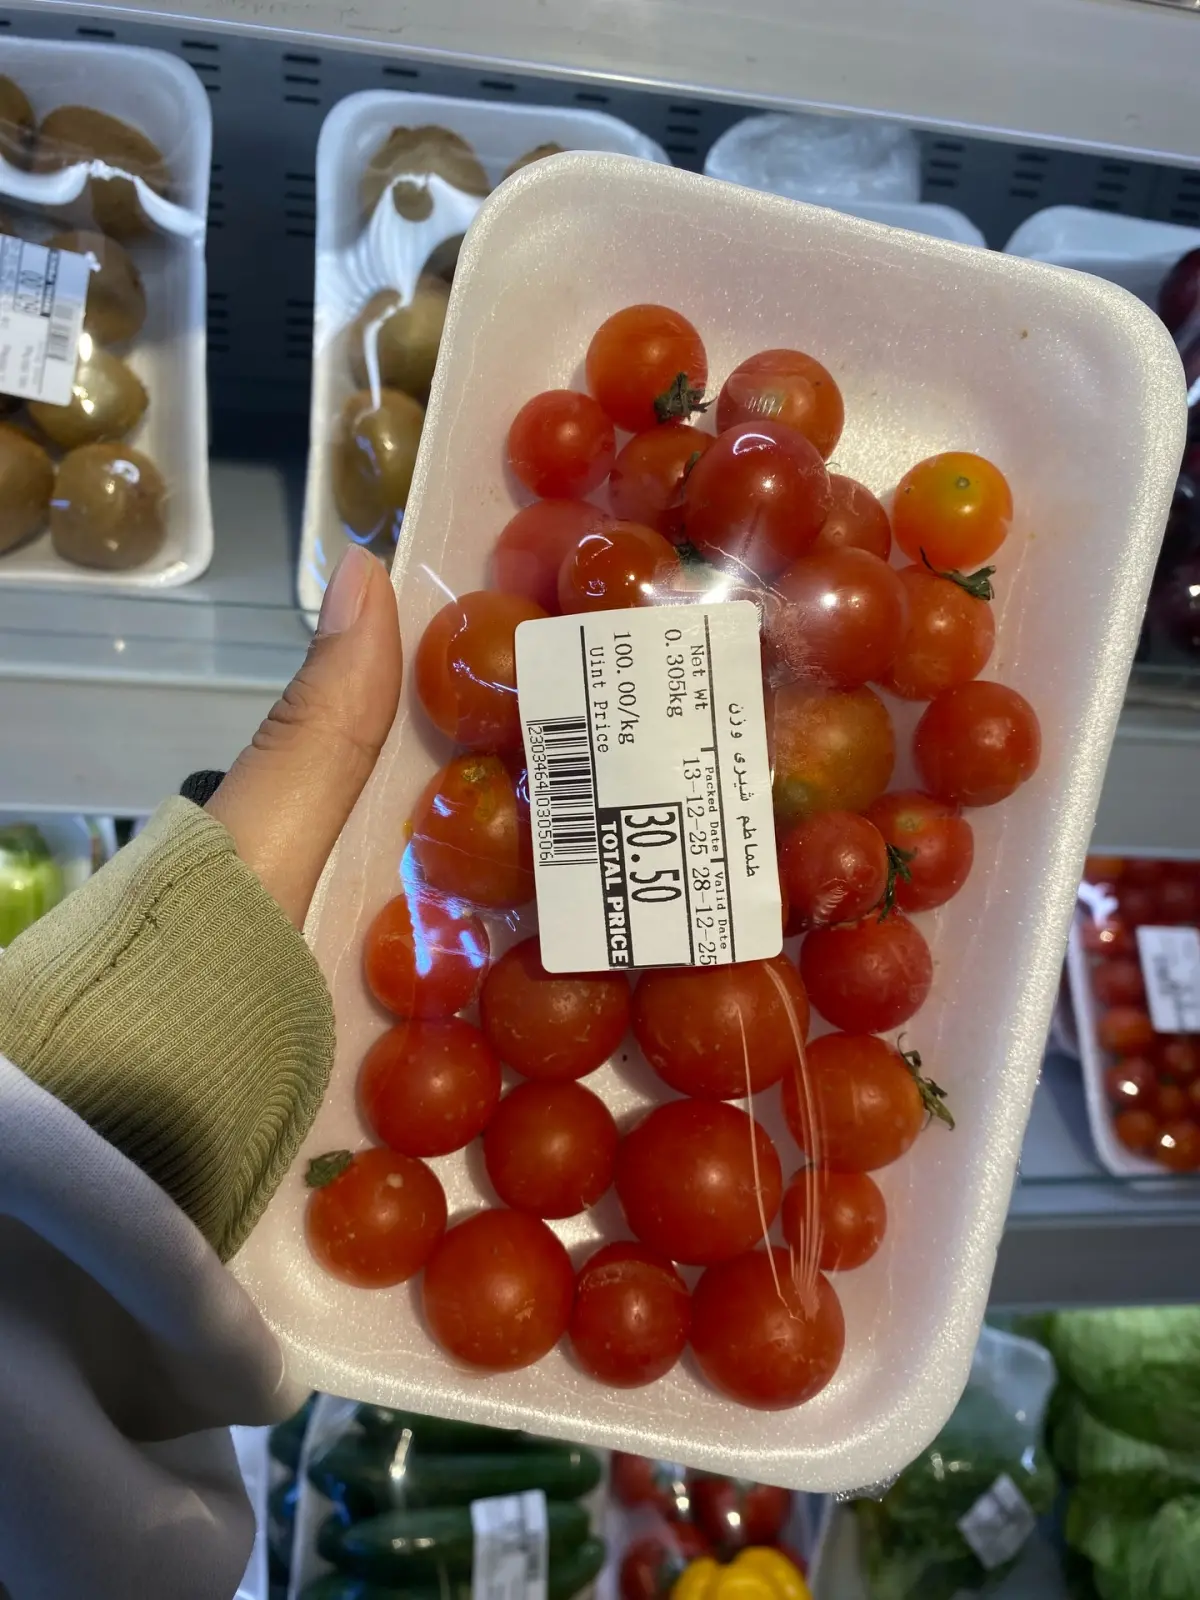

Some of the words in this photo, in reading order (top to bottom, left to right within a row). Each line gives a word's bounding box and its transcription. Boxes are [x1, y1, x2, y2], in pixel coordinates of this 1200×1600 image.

[589, 646, 606, 689] Uint
[691, 644, 705, 678] Net
[694, 688, 708, 711] Wt
[728, 703, 746, 739] وزن
[592, 701, 610, 754] Price
[682, 757, 708, 856] 13-12-25
[705, 766, 718, 813] Packed
[600, 821, 619, 890] TOTAL
[624, 810, 682, 903] 30.50
[709, 820, 721, 852] Date
[736, 815, 759, 878] طماطم
[714, 871, 726, 912] Valid
[608, 896, 628, 964] PRICE
[692, 866, 718, 966] 28-12-25
[718, 919, 728, 950] Date
